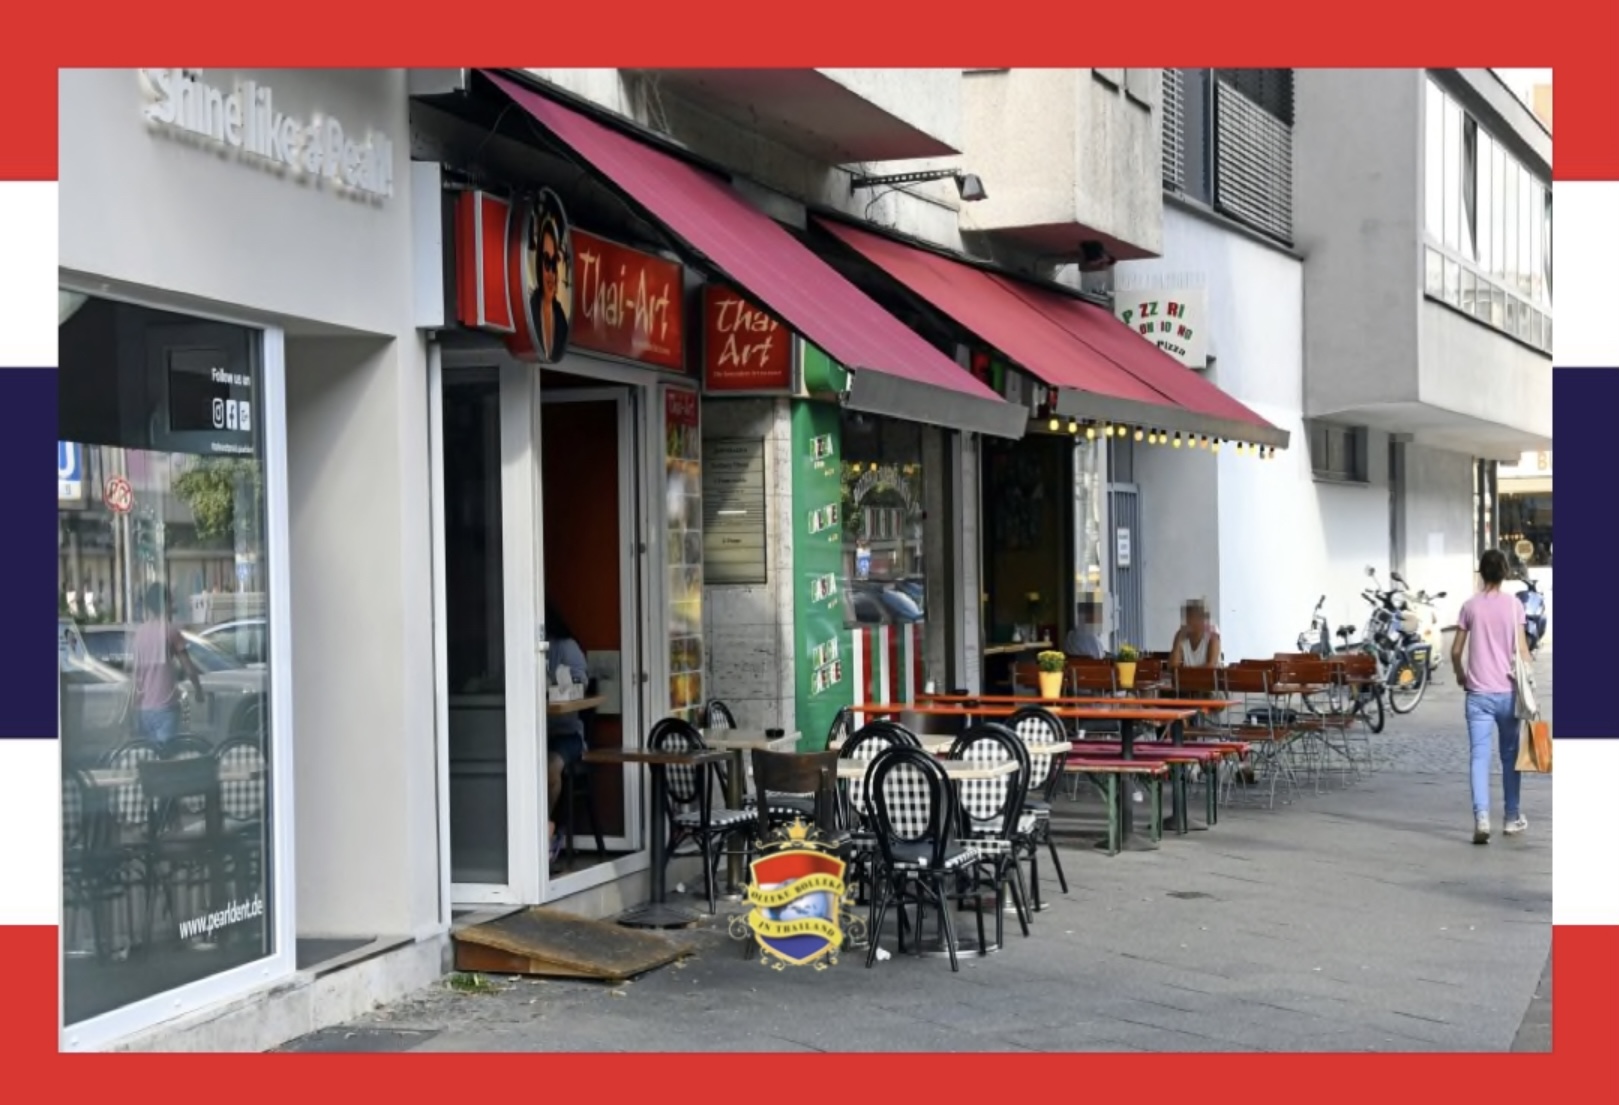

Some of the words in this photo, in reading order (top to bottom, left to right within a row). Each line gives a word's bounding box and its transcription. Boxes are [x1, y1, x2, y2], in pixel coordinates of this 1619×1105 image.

[243, 80, 297, 171] like
[303, 124, 323, 174] a
[579, 248, 670, 342] Thai-Art
[717, 333, 773, 368] Art
